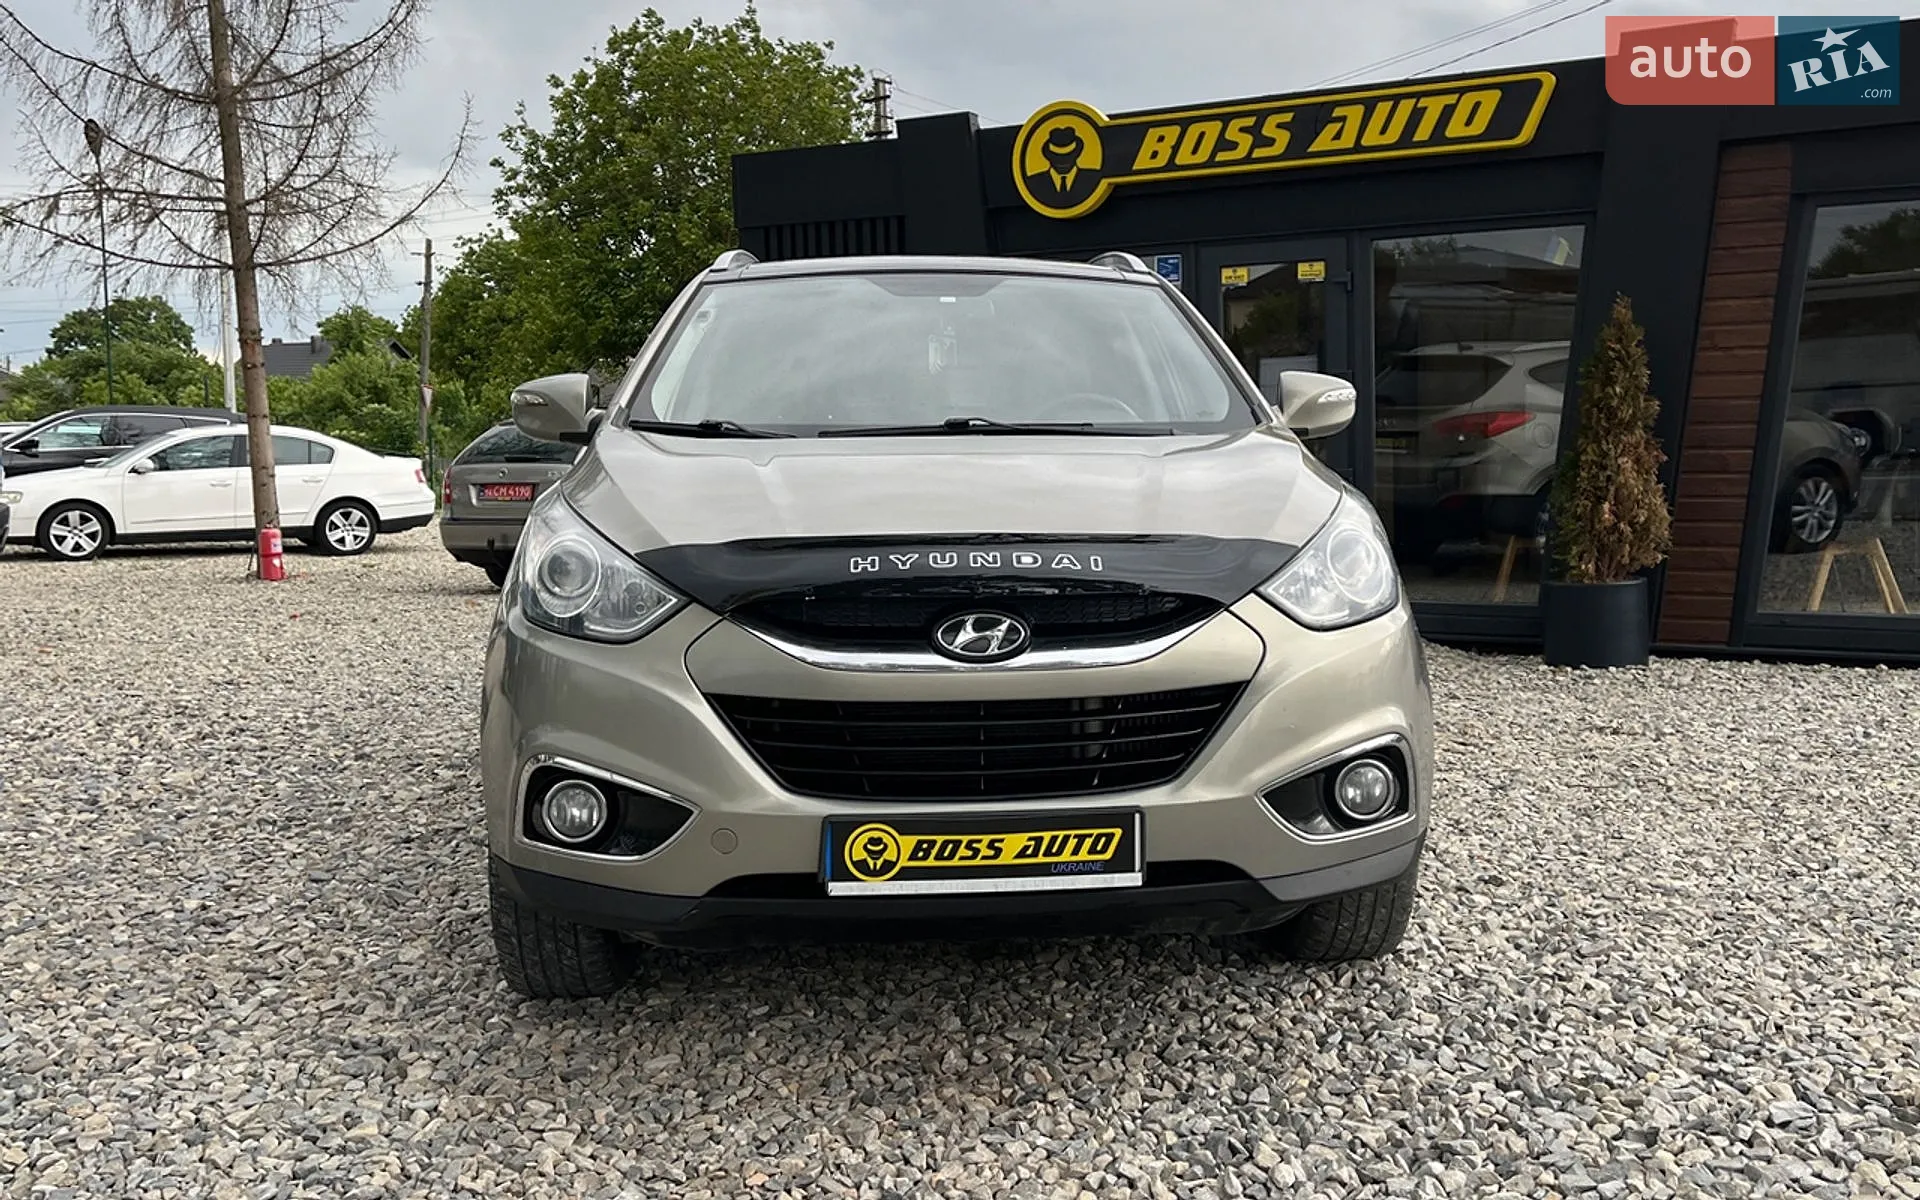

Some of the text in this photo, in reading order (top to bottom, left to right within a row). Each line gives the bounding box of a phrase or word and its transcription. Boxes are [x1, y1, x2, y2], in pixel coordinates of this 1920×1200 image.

[1132, 89, 1501, 170] BOSS AUTO
[850, 552, 1102, 573] HYUNDAI
[907, 832, 1115, 862] BOSS AUTO
[1051, 861, 1105, 873] UKRAINE
